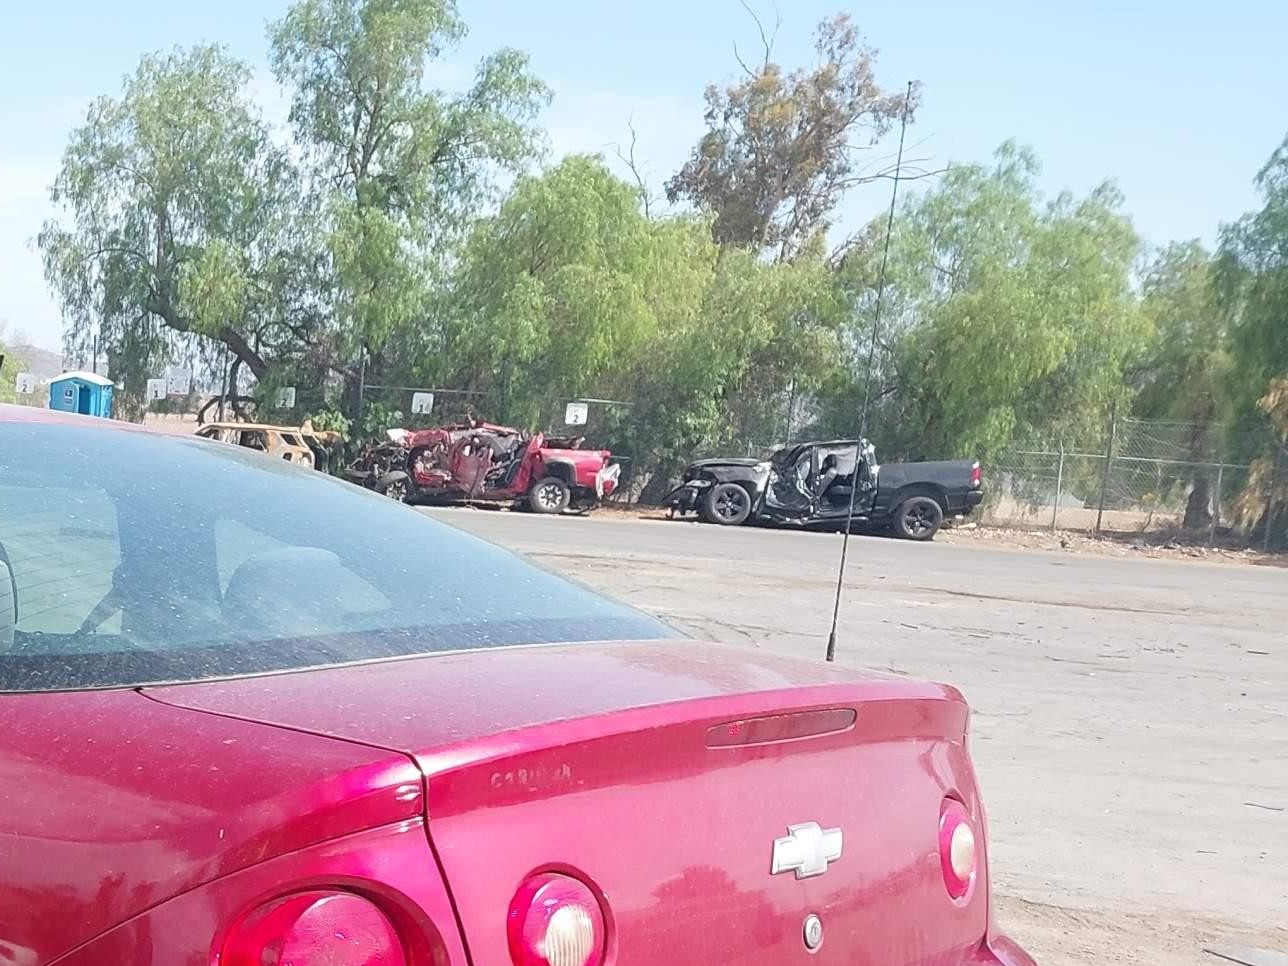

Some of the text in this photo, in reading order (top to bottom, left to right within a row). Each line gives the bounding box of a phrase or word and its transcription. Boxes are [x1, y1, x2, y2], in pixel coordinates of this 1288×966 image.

[21, 383, 28, 393] 2
[153, 390, 159, 399] 1
[418, 403, 424, 414] 1
[573, 413, 580, 424] 2
